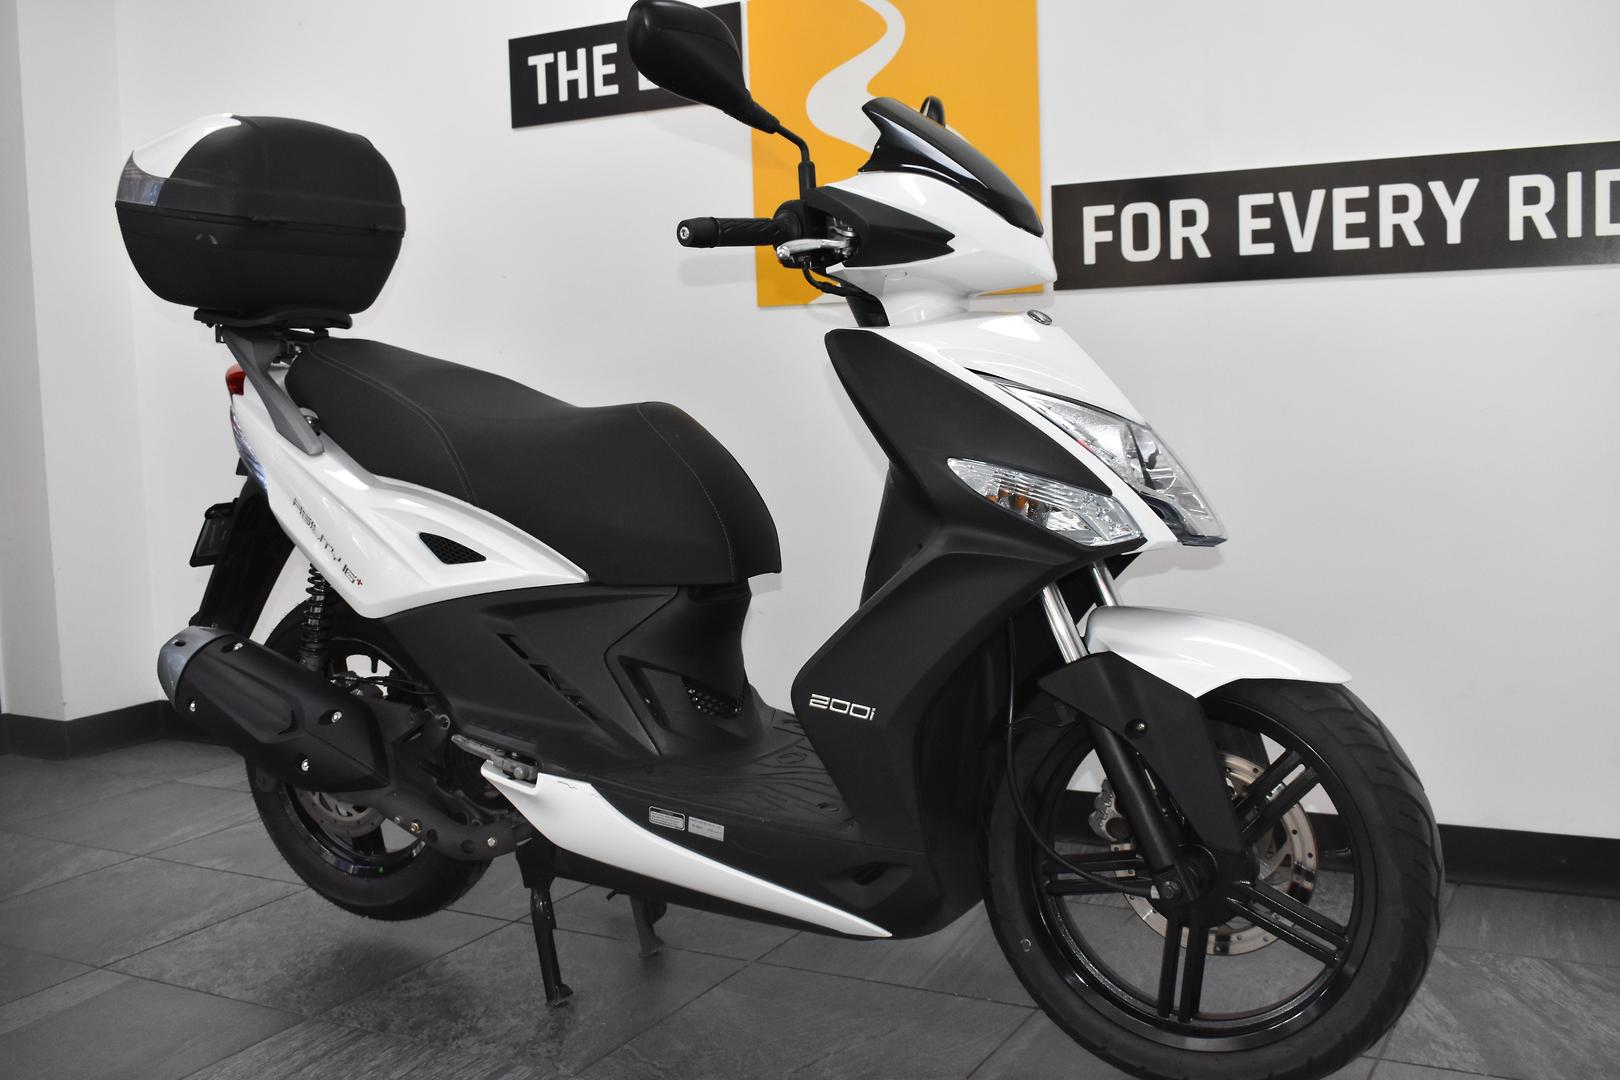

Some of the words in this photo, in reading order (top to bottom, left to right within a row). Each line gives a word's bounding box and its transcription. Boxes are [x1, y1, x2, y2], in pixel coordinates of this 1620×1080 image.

[527, 42, 619, 105] THE
[1082, 198, 1212, 265] FOR
[1238, 177, 1480, 256] EVERY
[808, 693, 876, 721] 200i
